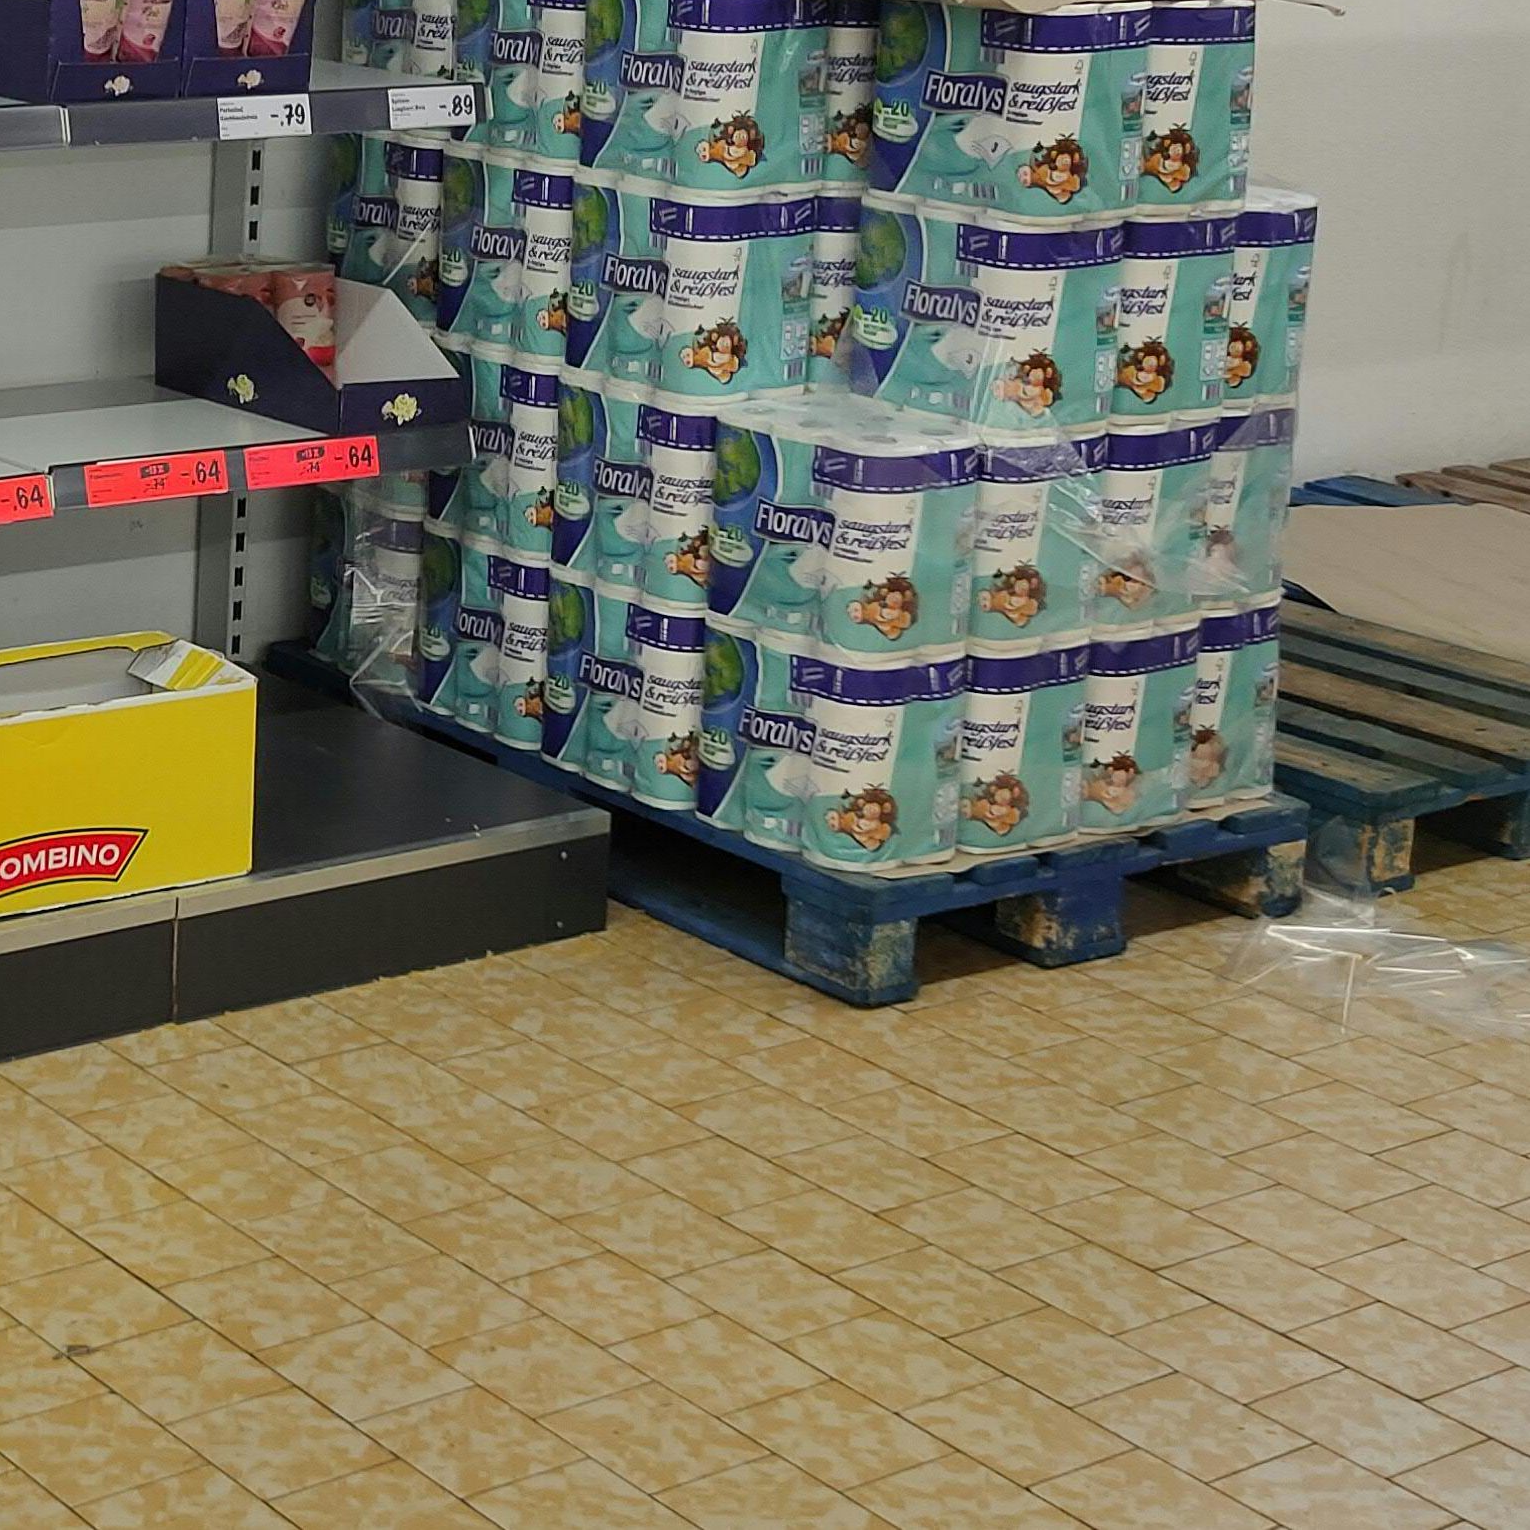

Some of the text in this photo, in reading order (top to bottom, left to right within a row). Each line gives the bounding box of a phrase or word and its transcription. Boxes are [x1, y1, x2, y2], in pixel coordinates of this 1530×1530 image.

[622, 53, 683, 89] Floralys
[688, 59, 757, 75] saugstark
[926, 75, 1005, 111] Floralys
[1011, 77, 1082, 98] saugstark
[270, 103, 305, 126] -.79
[439, 94, 472, 117] -.89
[605, 256, 668, 294] Floralys
[672, 266, 740, 282] saugstark
[904, 286, 979, 323] Floralys
[984, 293, 1054, 315] saugstark
[334, 444, 373, 469] -.64
[180, 461, 220, 486] -.64
[1, 485, 43, 511] -.64
[756, 503, 832, 546] Floralys
[838, 519, 913, 535] saugstark
[580, 657, 641, 697] Floralys
[738, 708, 814, 756] Floralys
[821, 727, 894, 746] saugstark
